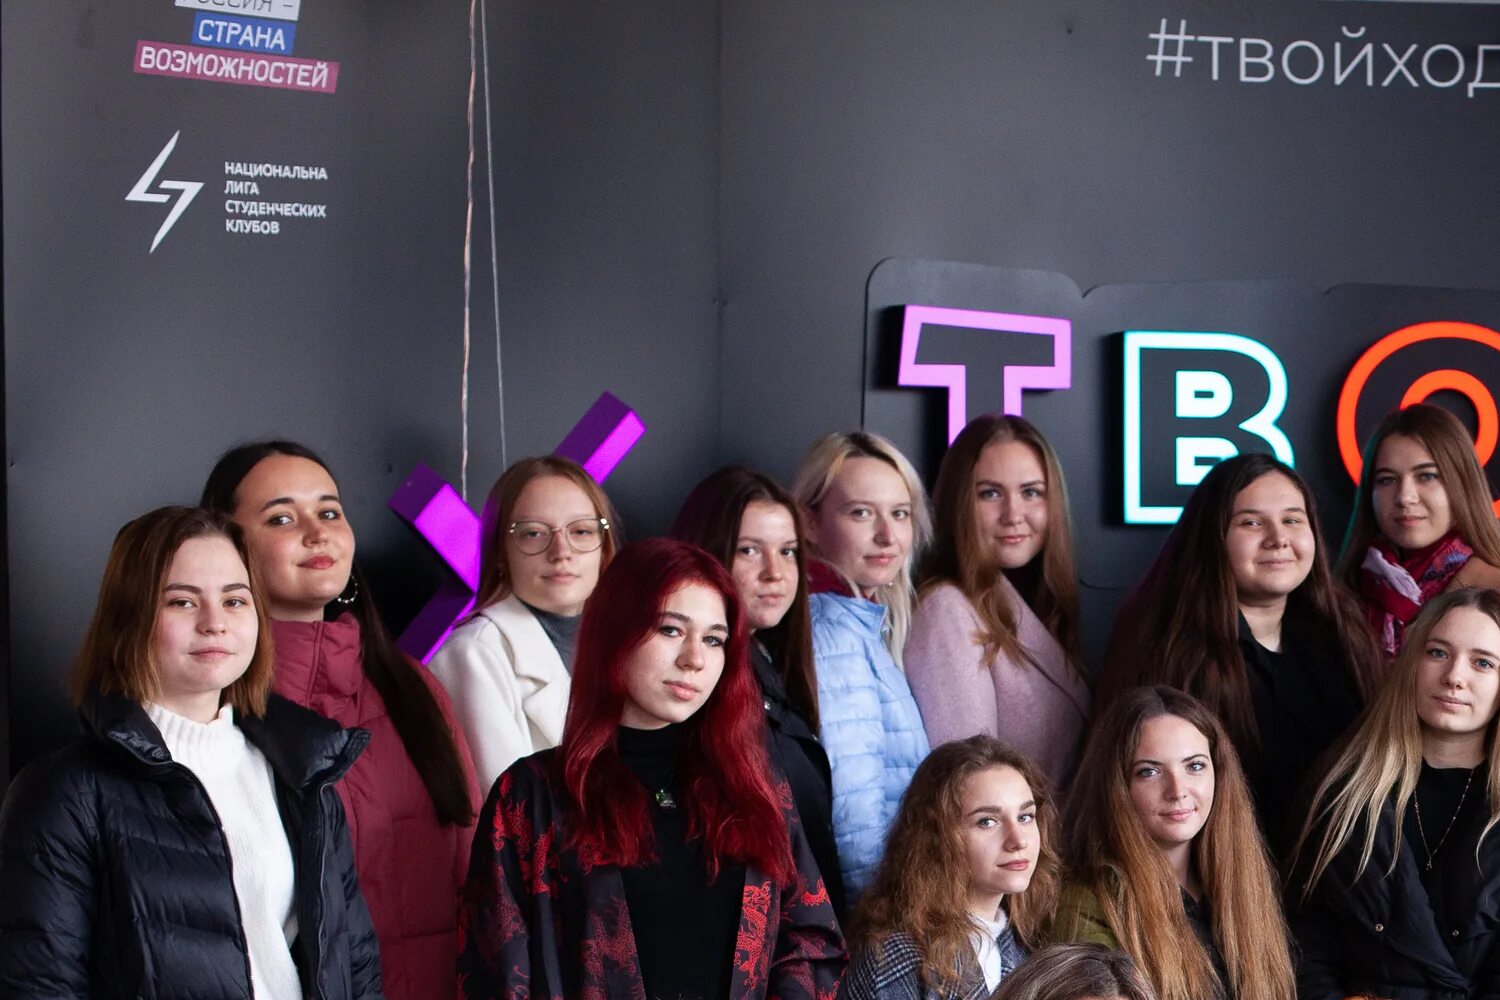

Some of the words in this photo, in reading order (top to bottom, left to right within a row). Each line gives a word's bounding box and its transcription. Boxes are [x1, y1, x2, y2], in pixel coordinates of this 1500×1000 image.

[198, 19, 286, 51] СТРАНА
[139, 46, 329, 88] ВОЗМОЖНОСТЕЙ
[224, 161, 329, 180] НАЦИОНАЛЬНА
[224, 180, 260, 195] ЛИГА
[225, 200, 328, 218] СТУДЕНЧЕСКИХ
[225, 219, 280, 235] КЛУБОВ
